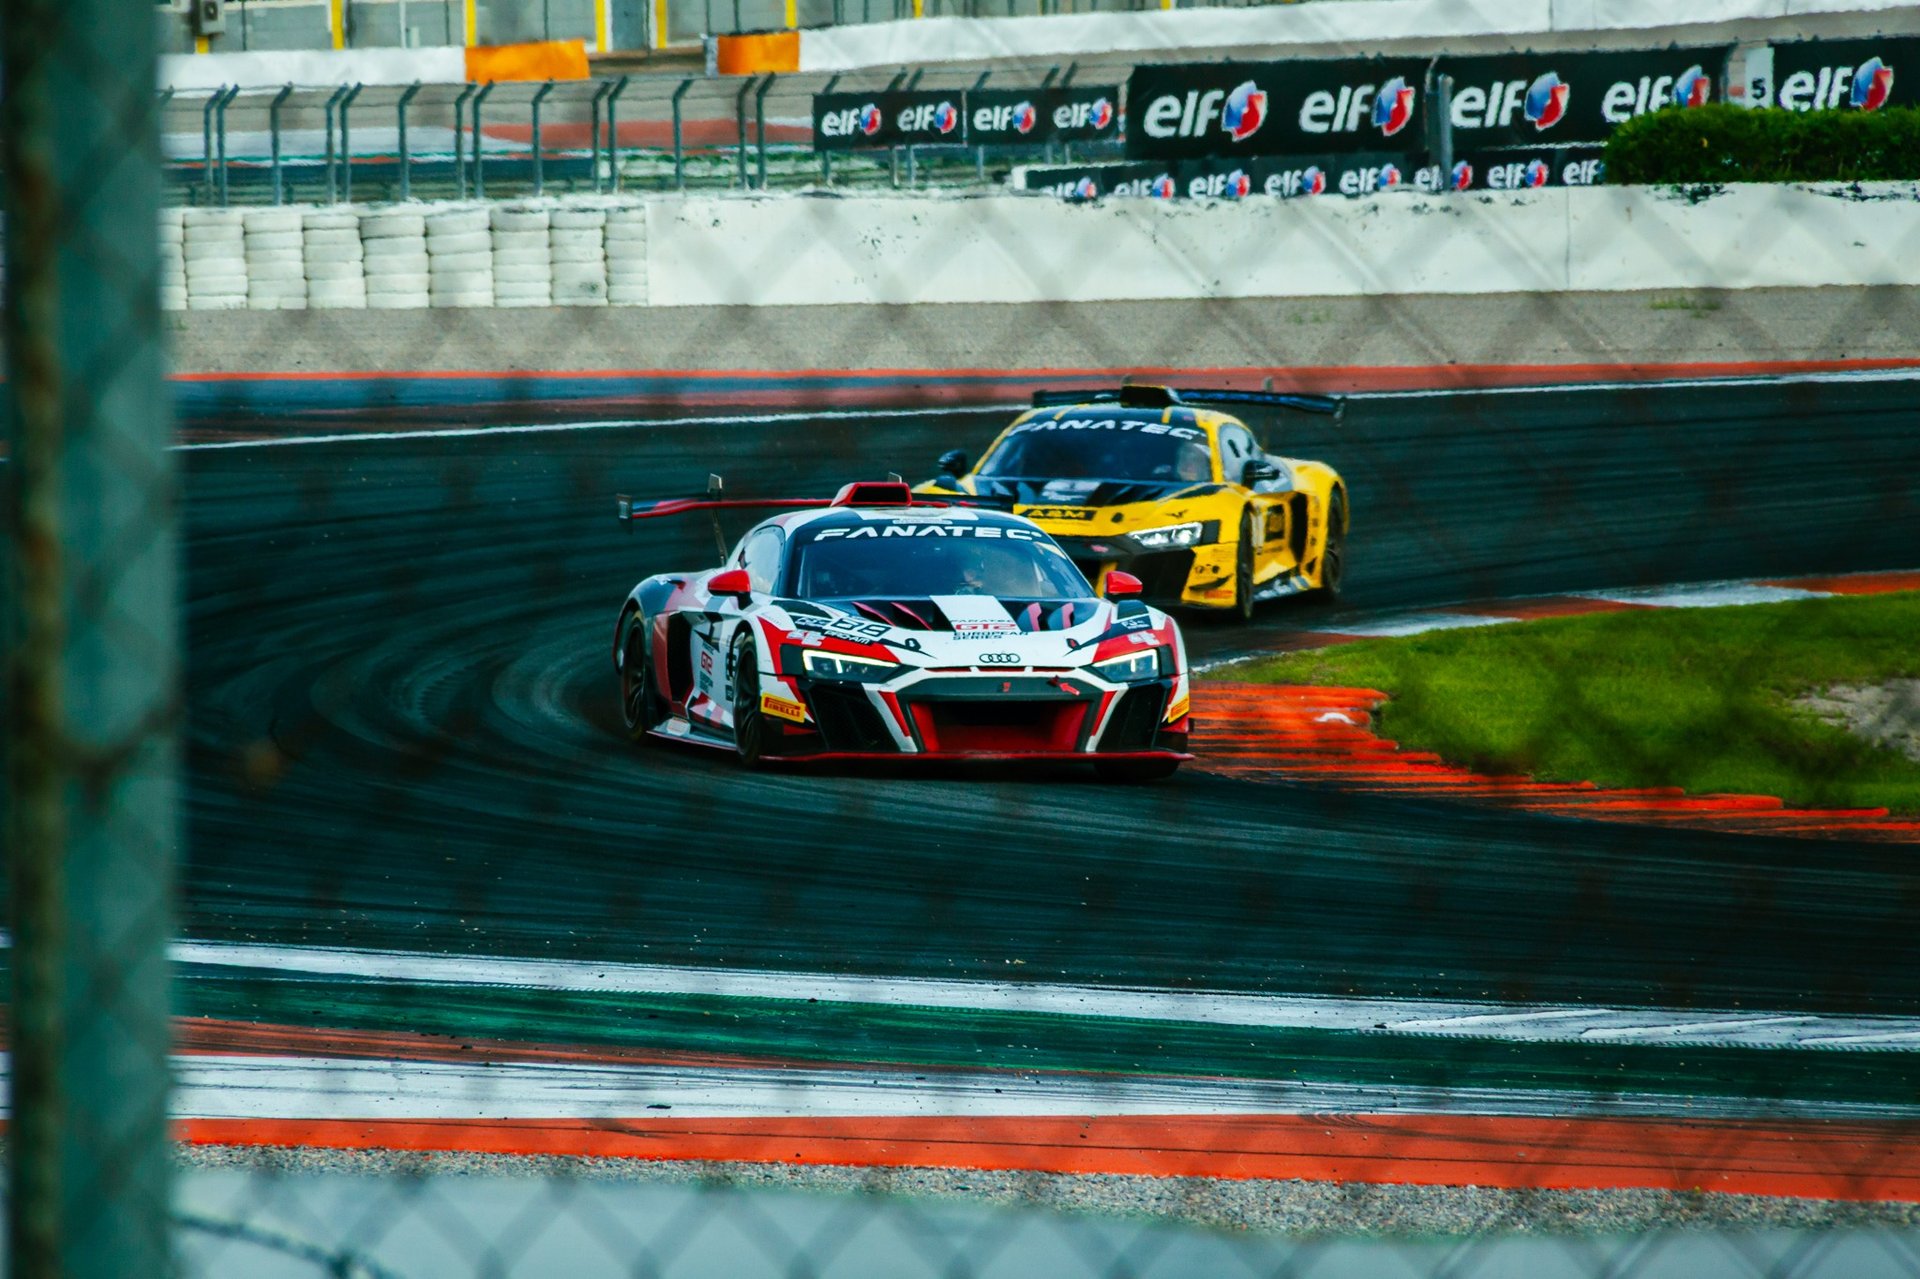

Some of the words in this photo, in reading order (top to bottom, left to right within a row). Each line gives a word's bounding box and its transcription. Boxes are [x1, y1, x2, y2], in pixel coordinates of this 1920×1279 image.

[1602, 75, 1673, 124] elf
[1752, 77, 1767, 100] 5
[1779, 66, 1854, 112] elf
[897, 103, 937, 132] elf
[1052, 101, 1091, 130] elf
[1143, 88, 1225, 139] elf
[1299, 83, 1376, 134] elf
[1450, 79, 1528, 129] elf
[821, 107, 860, 137] elf
[973, 105, 1013, 132] elf
[1189, 171, 1228, 199] elf
[1264, 169, 1303, 197] elf
[1340, 167, 1378, 193] elf
[1487, 161, 1526, 189] elf
[1562, 158, 1599, 187] elf
[1008, 419, 1199, 441] FANATEC
[814, 525, 1036, 542] FANATEC
[955, 623, 1016, 631] GT2
[764, 697, 802, 718] PIRELLI
